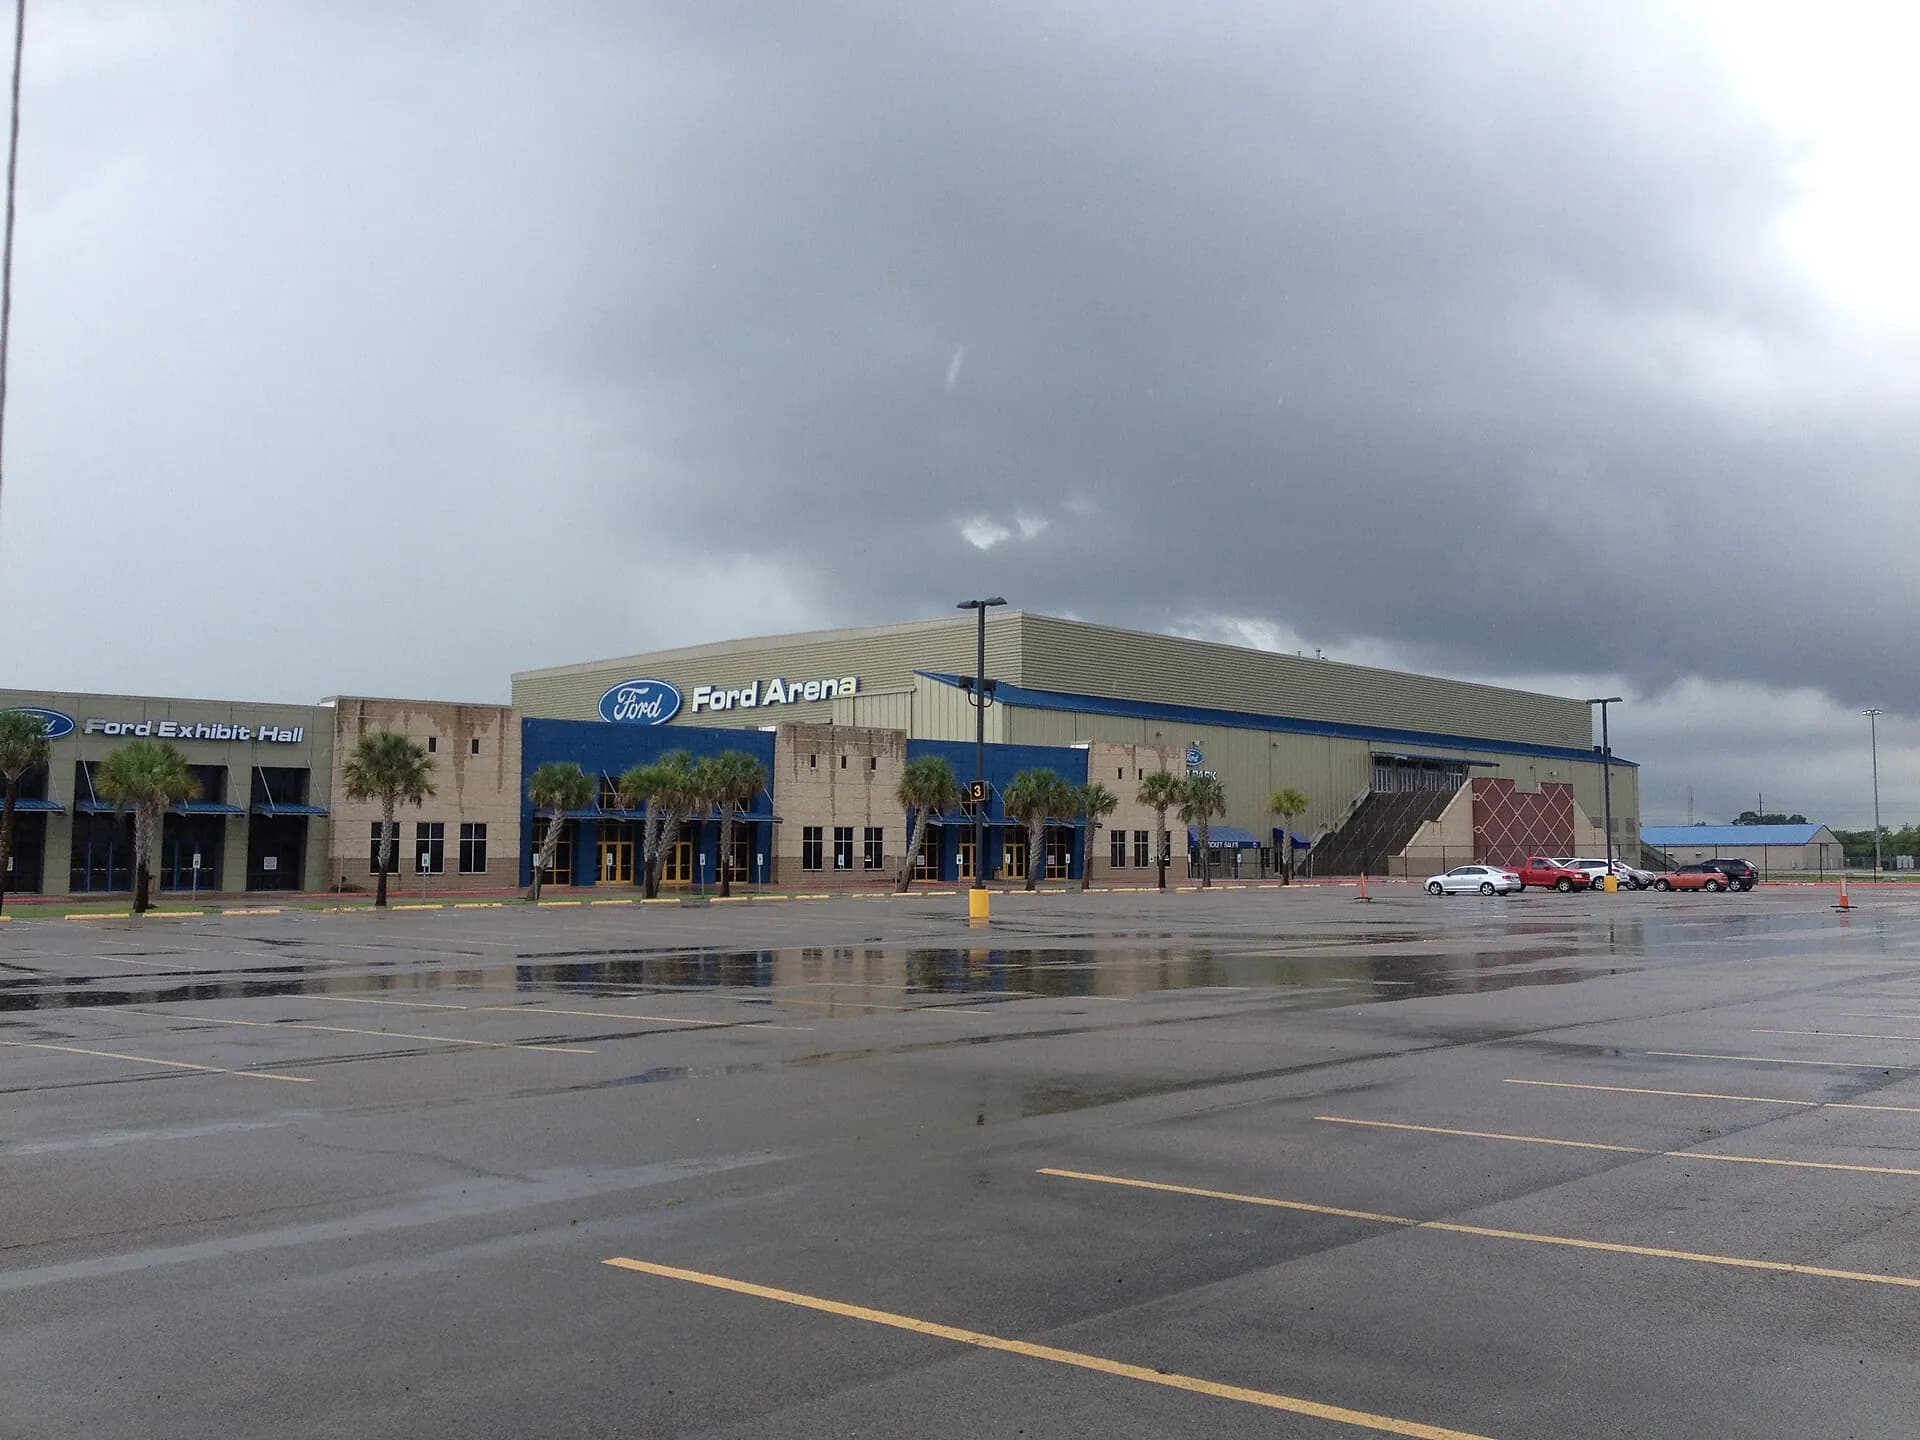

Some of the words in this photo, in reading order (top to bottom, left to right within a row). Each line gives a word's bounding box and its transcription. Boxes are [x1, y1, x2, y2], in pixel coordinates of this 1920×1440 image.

[613, 687, 663, 721] Ford
[691, 681, 759, 713] Ford
[762, 675, 858, 706] Arena
[84, 718, 153, 737] Ford
[158, 721, 250, 740] Exhibit
[257, 725, 304, 743] Hall
[974, 785, 981, 797] 3
